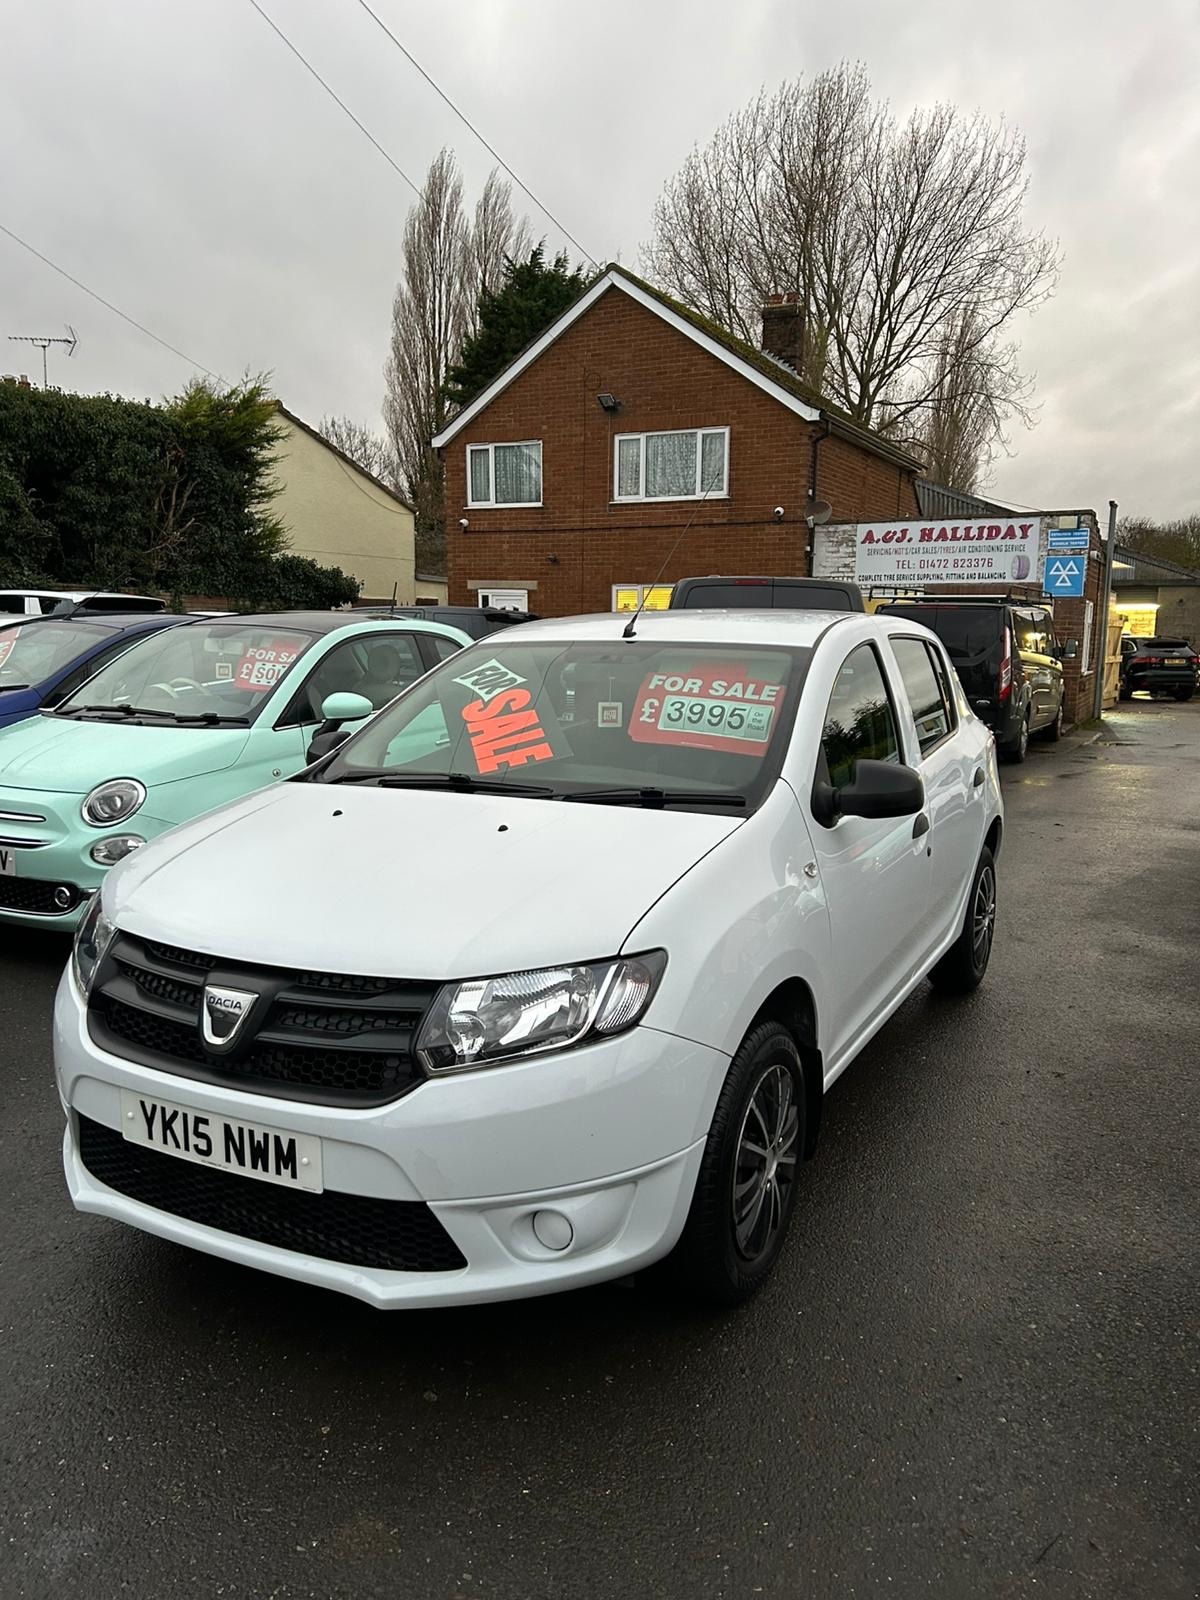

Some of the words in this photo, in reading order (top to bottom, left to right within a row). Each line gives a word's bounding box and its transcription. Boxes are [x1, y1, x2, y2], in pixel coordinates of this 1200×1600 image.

[919, 524, 1034, 542] HALLIDAY
[968, 544, 1003, 553] CONDITIONING
[1004, 543, 1026, 553] SERVICE
[896, 559, 916, 570] TEL:
[919, 558, 949, 569] 01472
[953, 557, 993, 568] 823376
[858, 574, 883, 582] COMPLETE
[883, 574, 895, 582] TYRE
[896, 573, 916, 581] SERVICE
[945, 572, 965, 580] FITTING
[966, 572, 977, 580] AND
[977, 571, 1007, 580] BALANCING
[246, 648, 276, 661] FOR
[278, 651, 298, 662] SA
[239, 663, 253, 679] £
[459, 665, 518, 695] FOR
[648, 675, 703, 693] FOR
[708, 680, 781, 701] SALE
[639, 698, 660, 723] £
[666, 700, 747, 730] 3995
[462, 688, 554, 774] SALE
[208, 995, 242, 1010] DACIA
[139, 1099, 213, 1157] YK15
[223, 1122, 298, 1180] NWM
